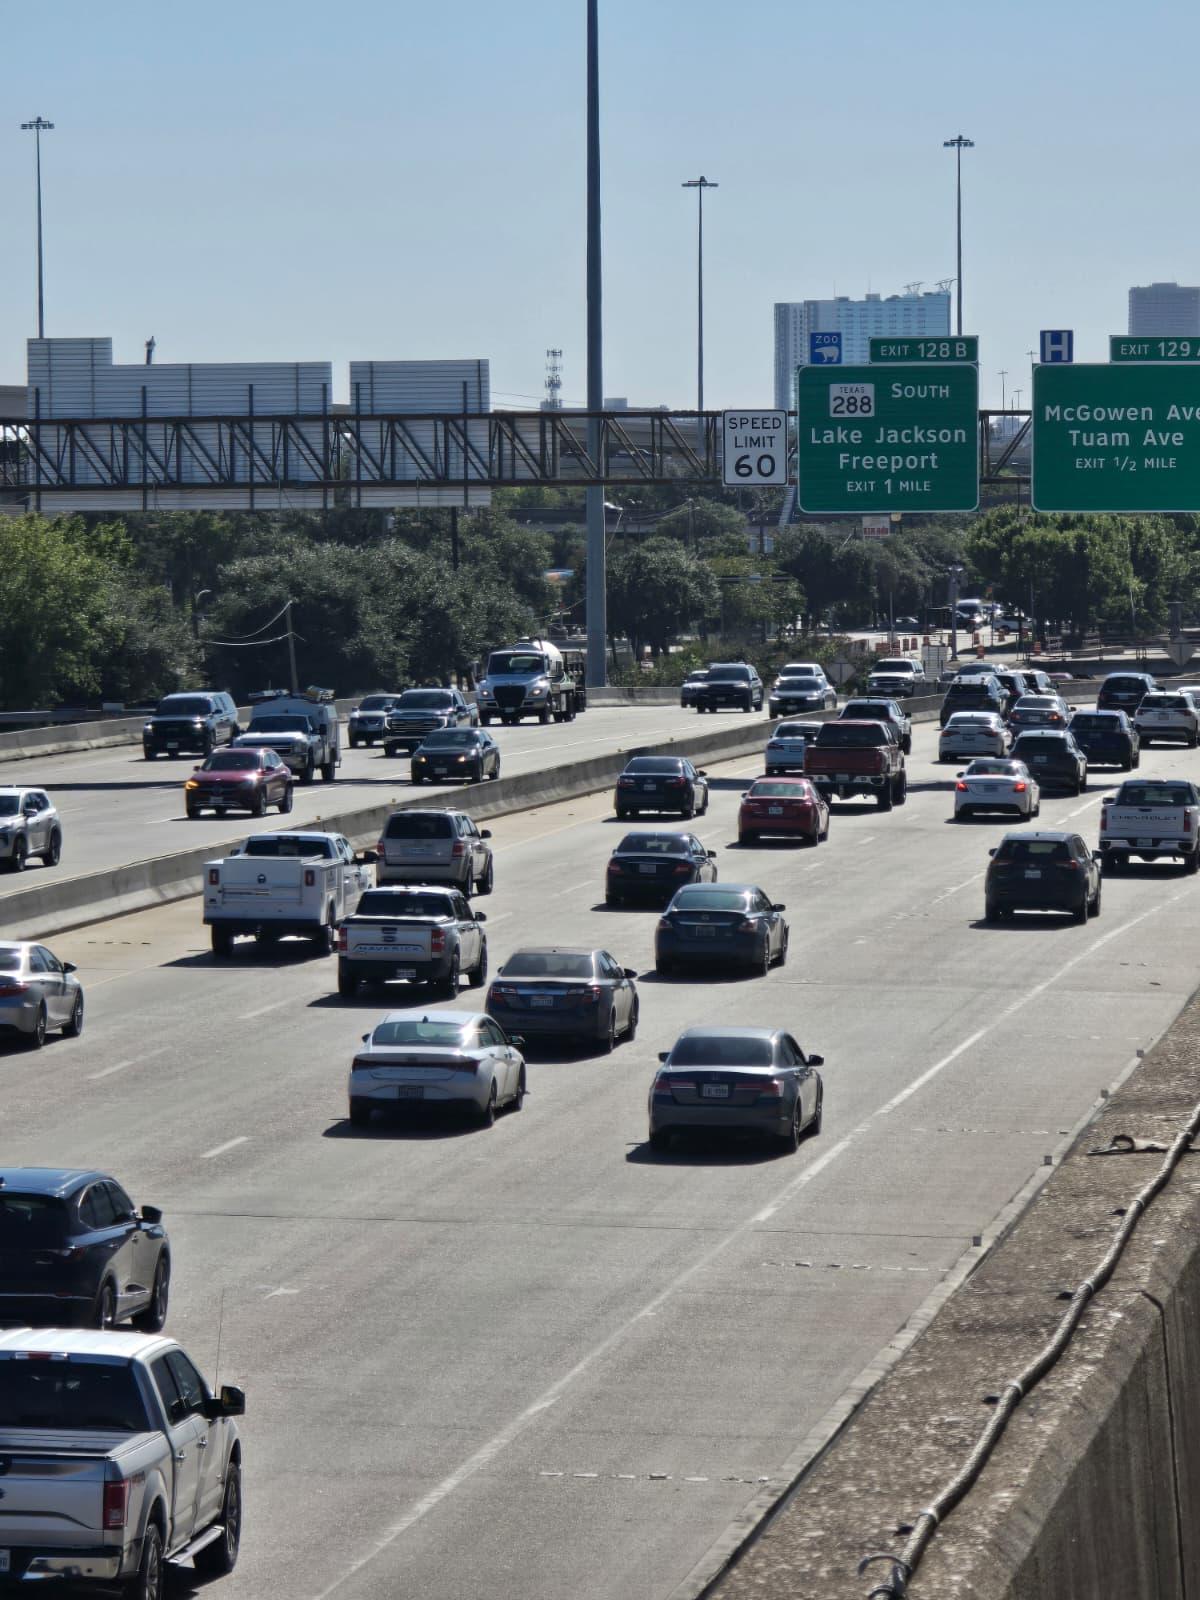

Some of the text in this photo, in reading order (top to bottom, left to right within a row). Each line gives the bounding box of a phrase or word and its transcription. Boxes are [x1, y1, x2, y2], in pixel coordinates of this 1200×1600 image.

[815, 335, 839, 344] ZOO
[1045, 332, 1069, 361] H
[880, 342, 967, 358] EXIT 128 B
[1120, 344, 1149, 355] EXIT
[1158, 341, 1191, 357] 129
[839, 386, 865, 394] TEXAS
[891, 383, 950, 398] SOUTH
[832, 395, 872, 414] 288
[1045, 405, 1153, 421] McGowen
[728, 417, 782, 430] SPEED
[734, 435, 776, 449] LIMIT
[811, 425, 966, 444] Lake Jackson
[1068, 429, 1184, 446] Tuam Ave
[734, 454, 776, 478] 60
[839, 453, 938, 473] Freeport
[1075, 456, 1177, 471] EXIT 1/2 MILE
[847, 478, 932, 494] EXIT 1 MILE
